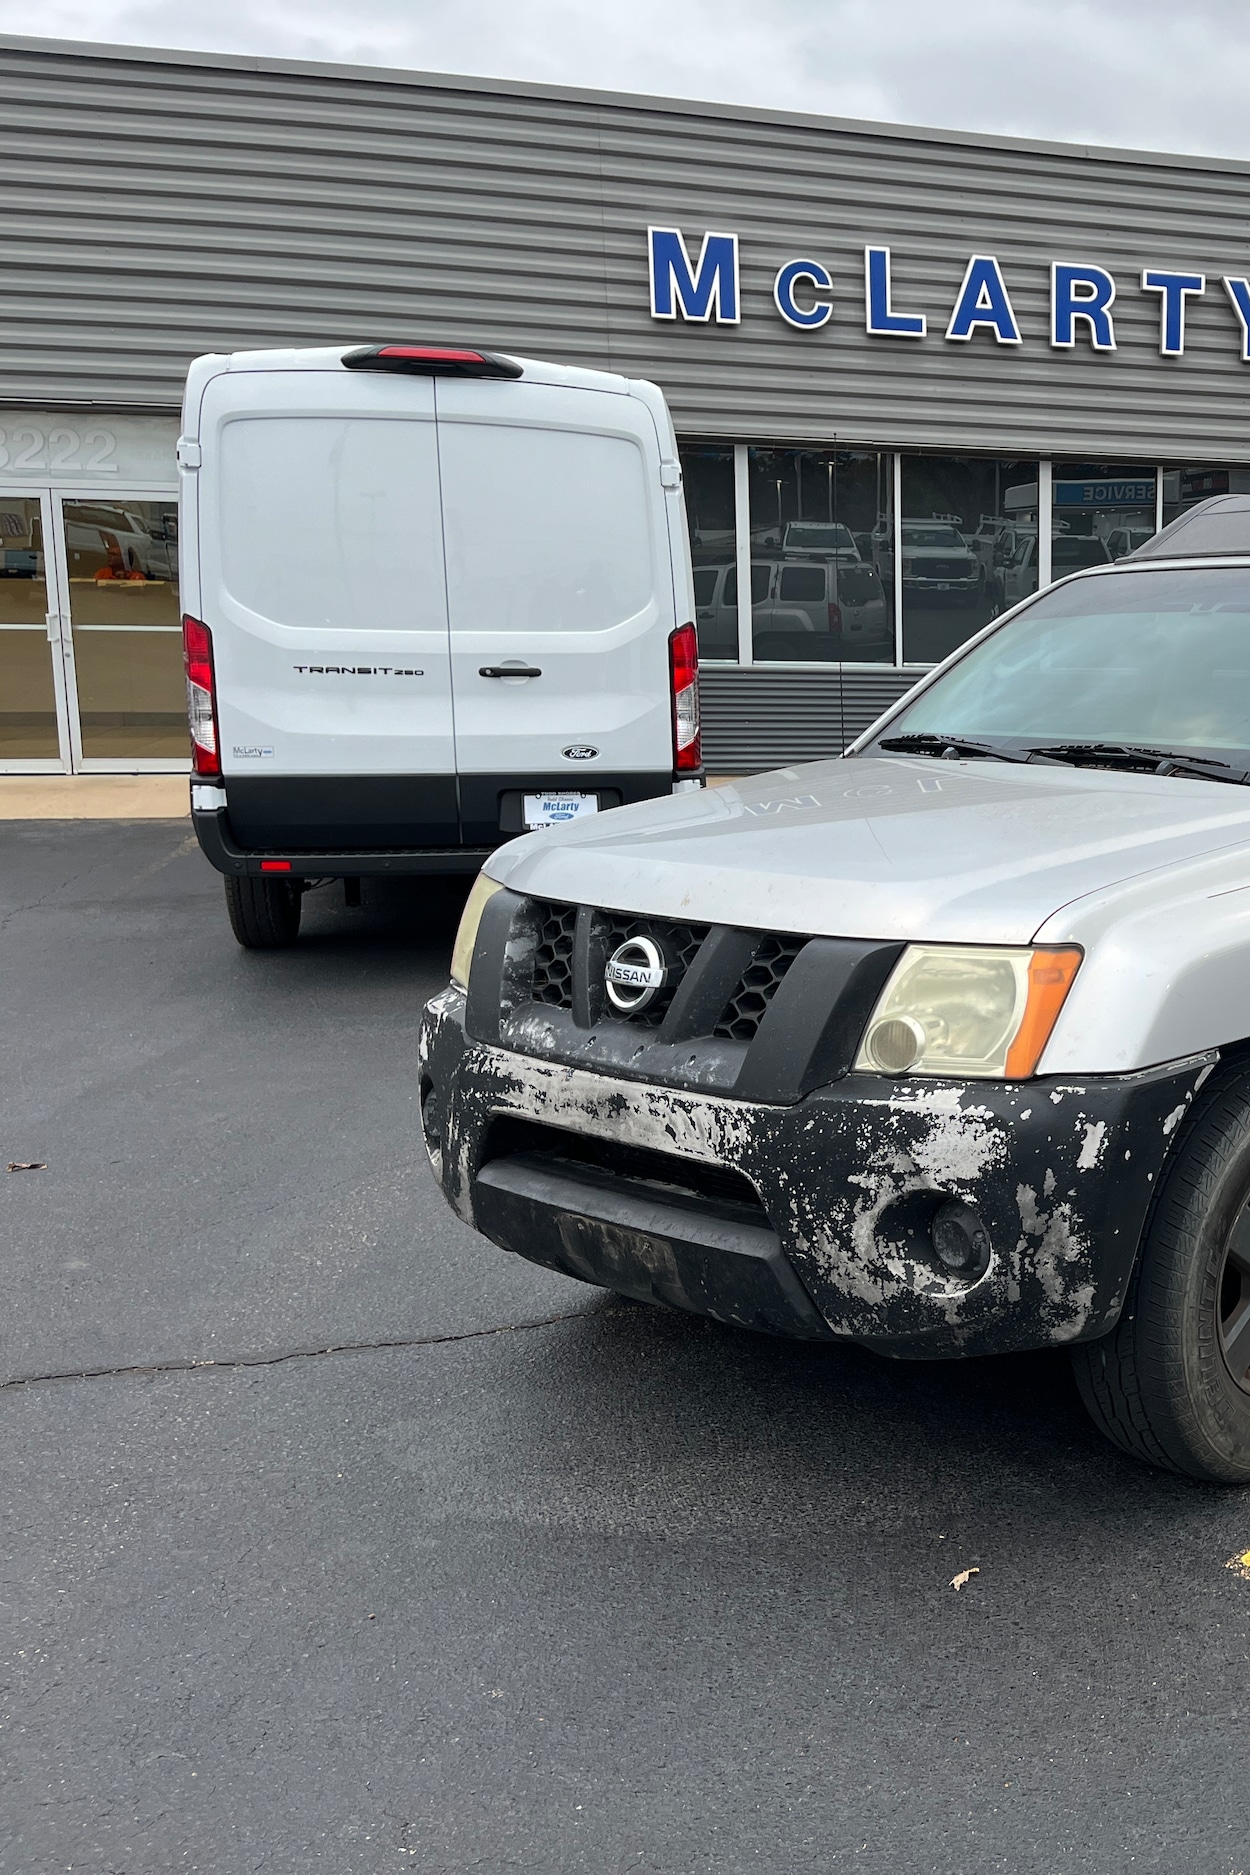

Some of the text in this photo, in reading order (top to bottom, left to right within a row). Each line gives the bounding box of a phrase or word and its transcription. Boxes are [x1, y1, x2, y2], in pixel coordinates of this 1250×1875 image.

[0, 427, 119, 472] 222
[293, 666, 393, 675] TRANSIT
[542, 802, 580, 811] McLarty
[605, 962, 652, 984] NISSAN
